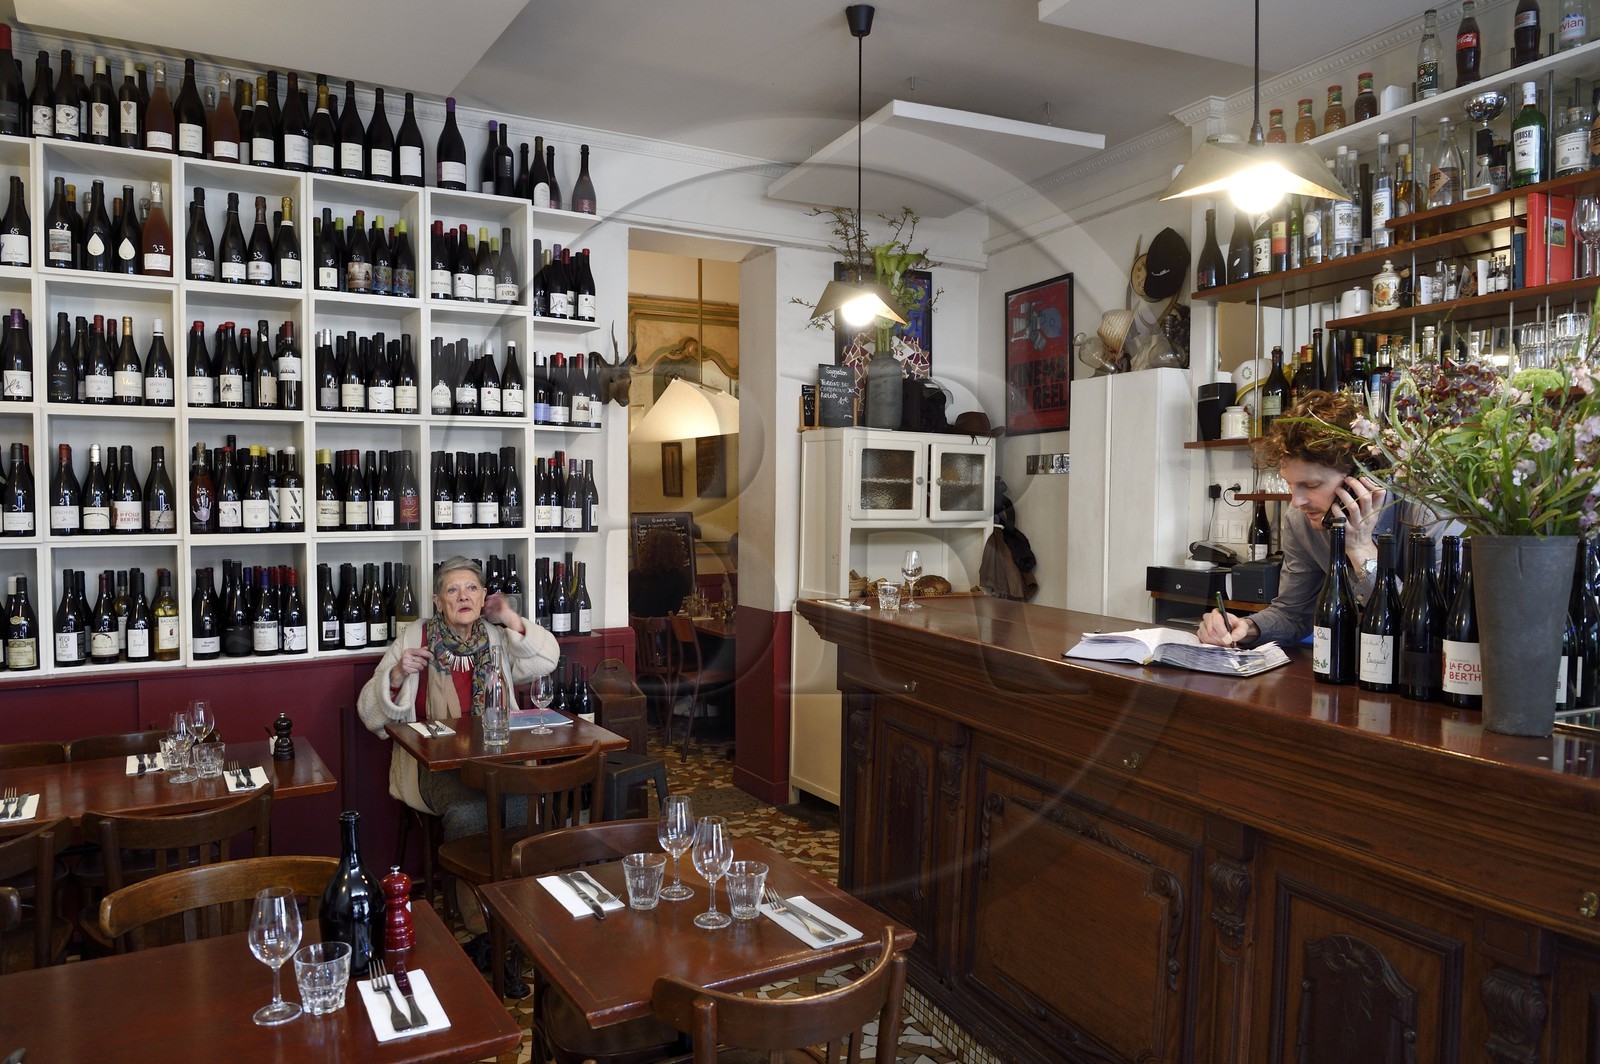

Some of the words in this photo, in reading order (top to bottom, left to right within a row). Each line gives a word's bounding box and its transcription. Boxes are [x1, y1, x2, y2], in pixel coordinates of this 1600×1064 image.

[1559, 19, 1584, 32] evian
[1010, 356, 1066, 388] CINEMA
[1033, 383, 1067, 410] REEL
[1457, 661, 1482, 673] FOLL
[1449, 671, 1482, 681] BERTH
